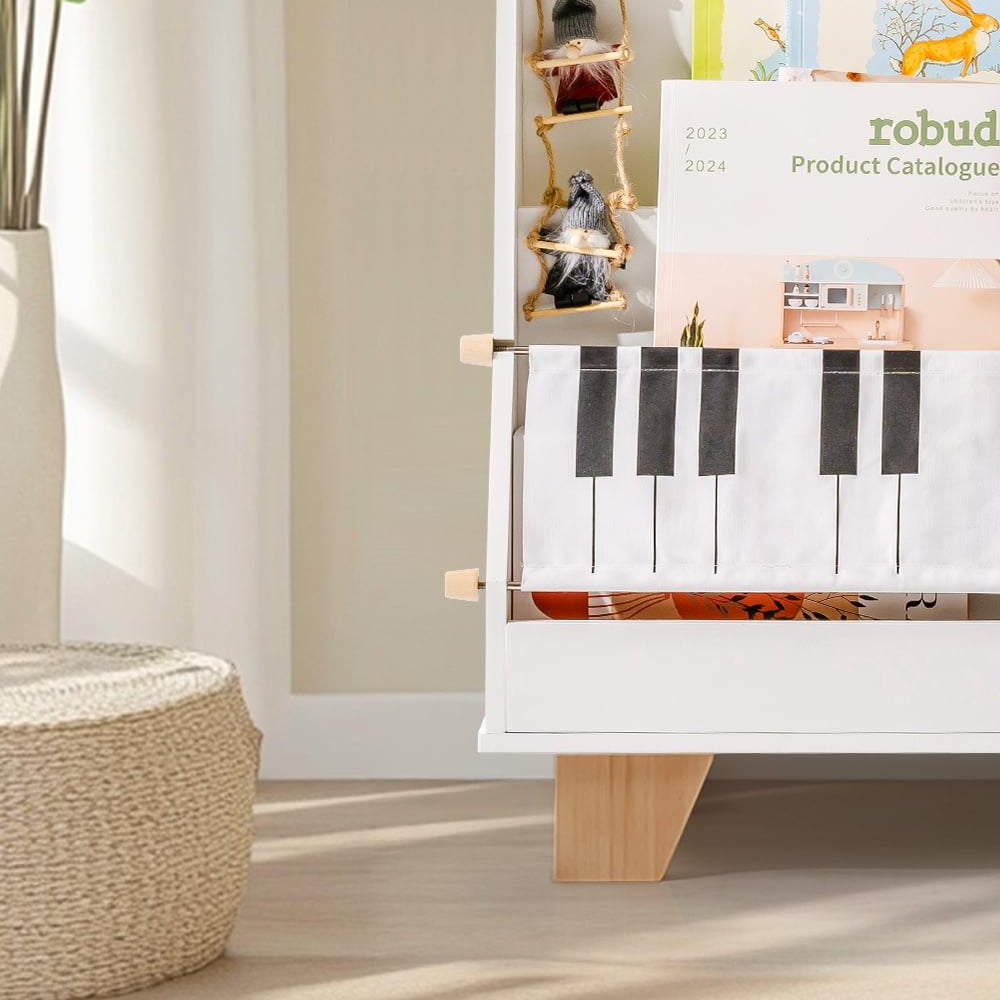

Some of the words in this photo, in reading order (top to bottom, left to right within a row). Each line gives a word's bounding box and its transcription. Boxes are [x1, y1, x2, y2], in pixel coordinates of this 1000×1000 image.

[686, 127, 728, 140] 2023
[869, 108, 1000, 147] robud
[685, 159, 726, 173] 2024
[791, 155, 881, 175] Product
[887, 156, 1000, 181] Catalogue
